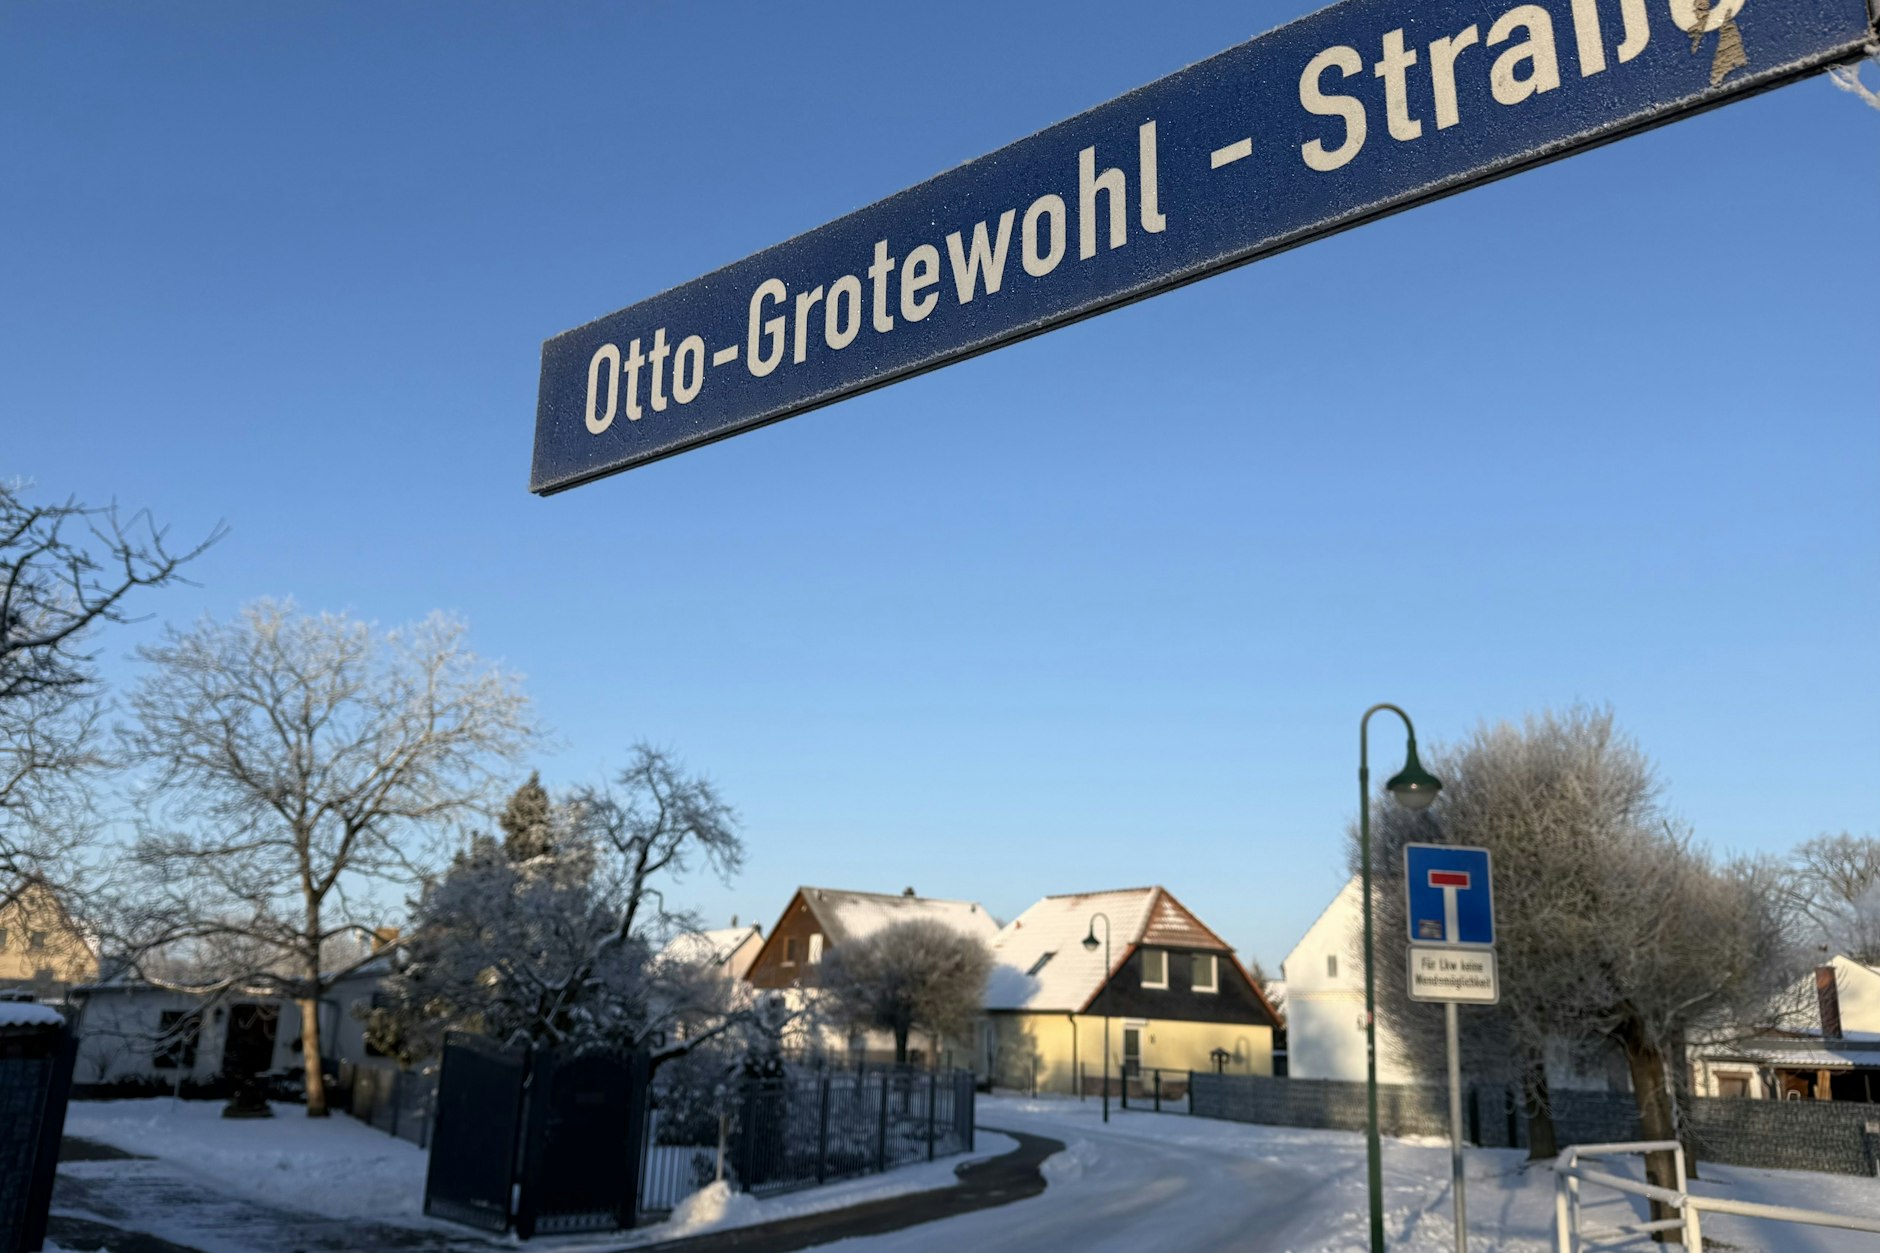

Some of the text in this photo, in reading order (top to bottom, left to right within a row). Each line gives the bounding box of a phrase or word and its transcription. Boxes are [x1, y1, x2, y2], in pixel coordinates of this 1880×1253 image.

[585, 120, 1167, 434] Otto-Grotewohl
[1421, 956, 1483, 972] Für Lkw keine
